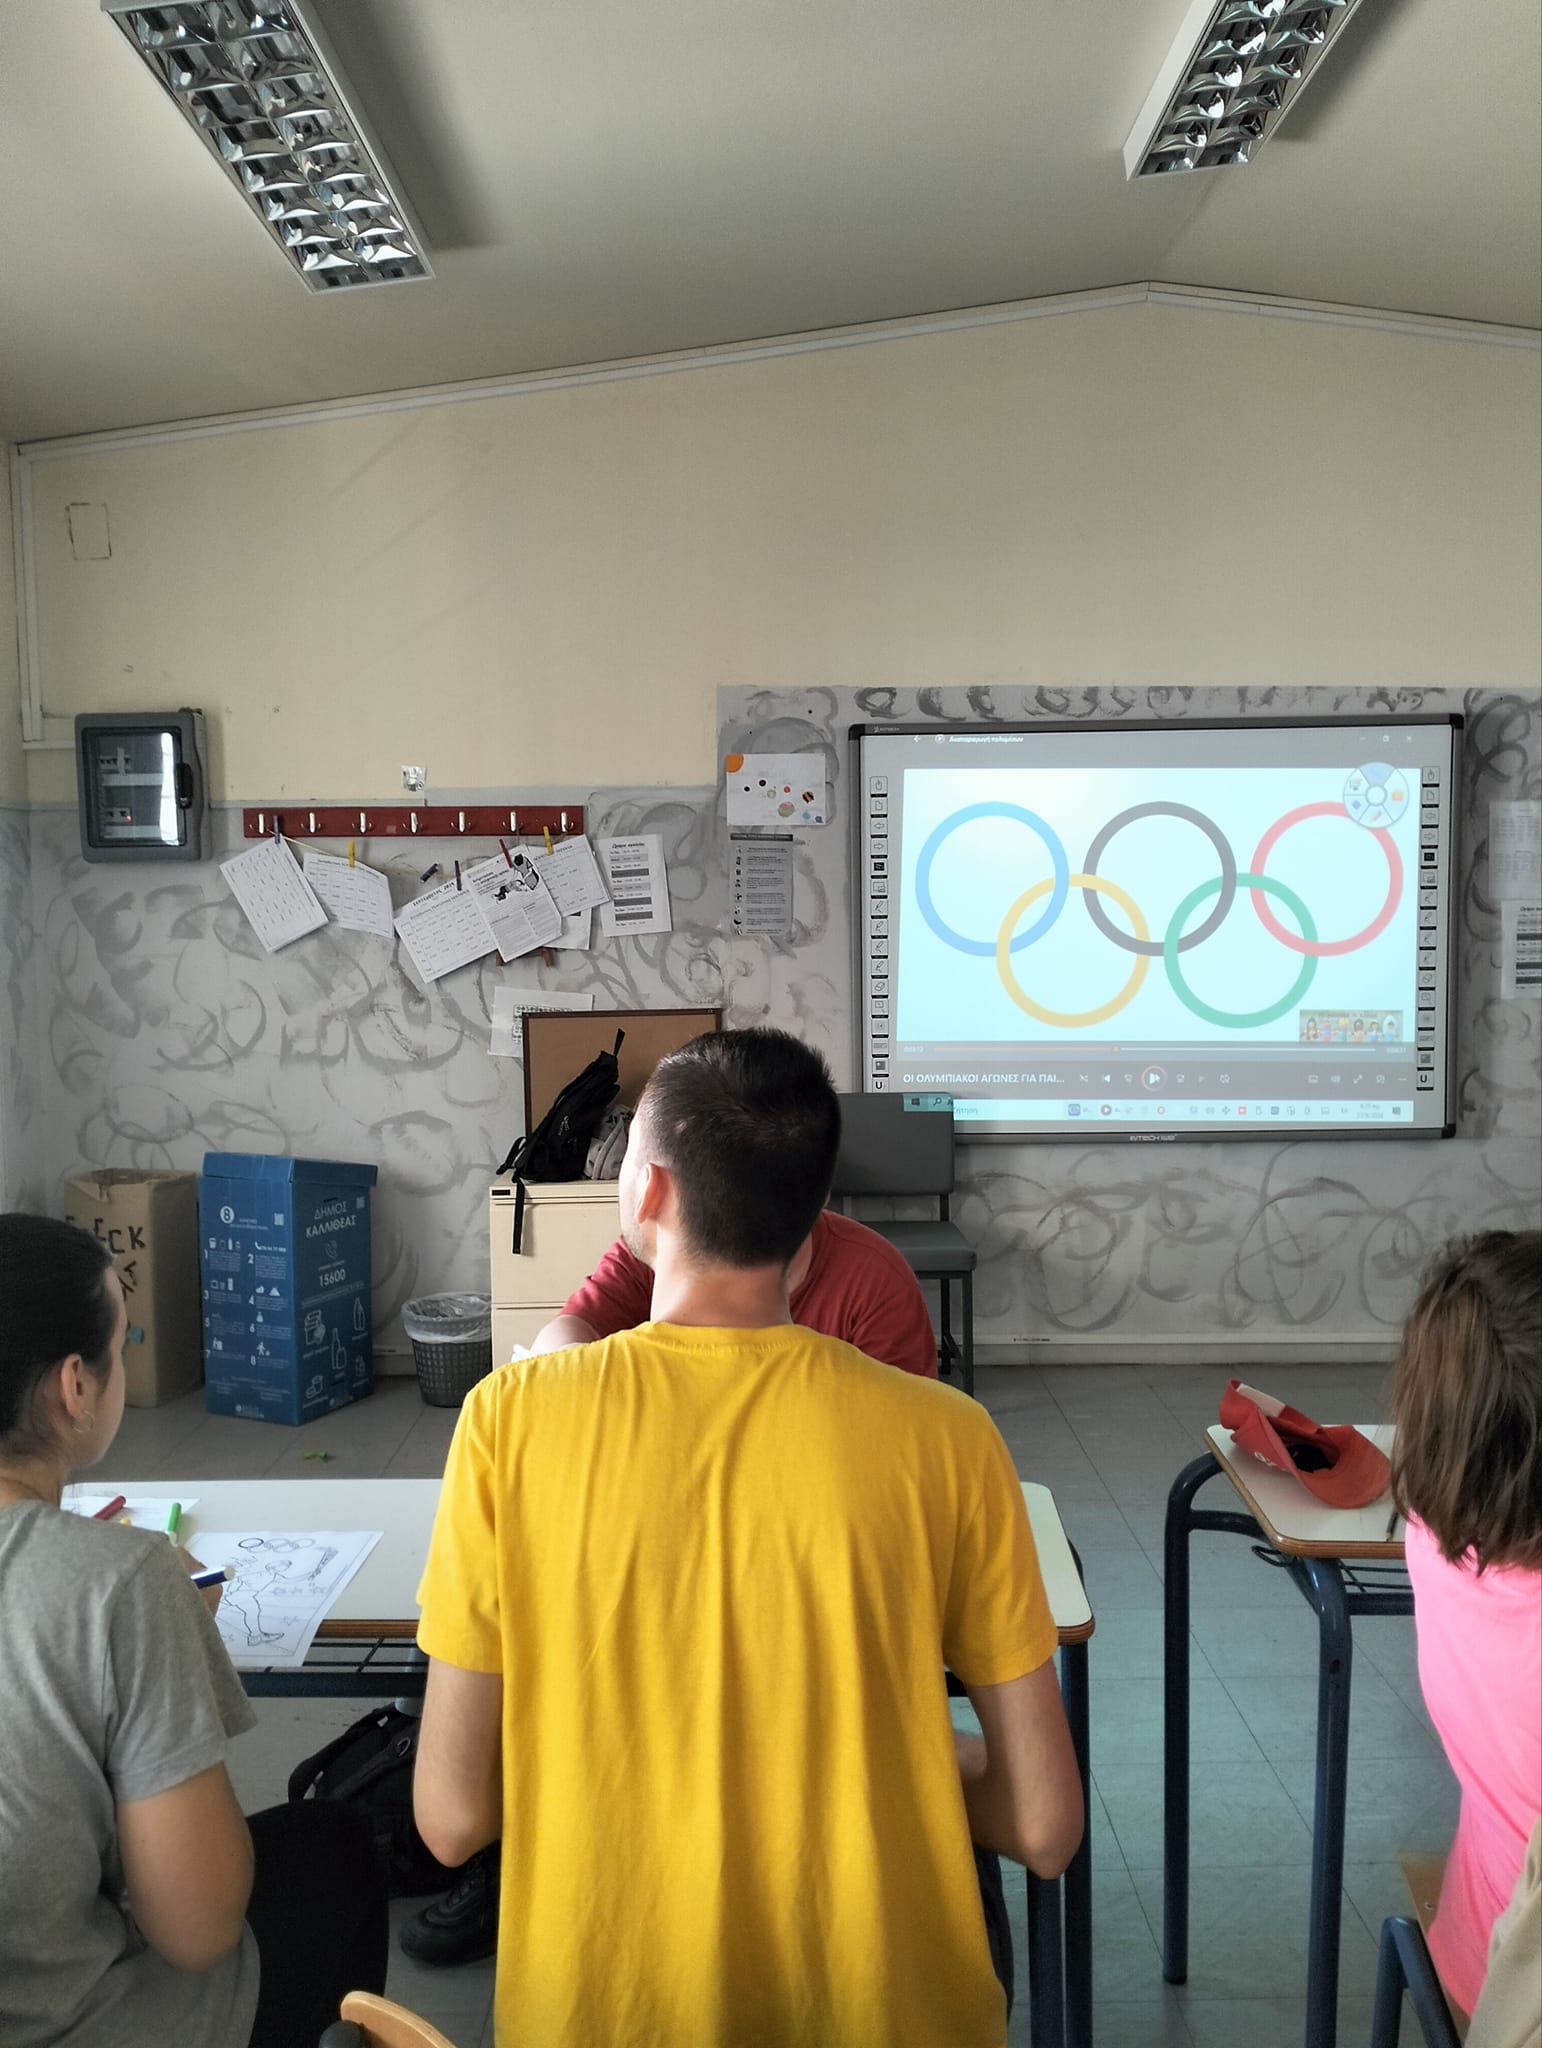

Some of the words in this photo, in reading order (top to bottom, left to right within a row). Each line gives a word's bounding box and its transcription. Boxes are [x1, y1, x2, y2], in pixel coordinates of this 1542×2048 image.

[903, 1074, 914, 1083] ΟΙ
[916, 1074, 979, 1083] ΟΛΥΜΠΙΑΚΟΙ
[980, 1074, 1019, 1083] ΑΓΩΝΕΣ
[1021, 1074, 1037, 1083] ΓΙΑ
[314, 1201, 347, 1220] ΔΗΜΟΣ
[305, 1214, 357, 1238] ΚΑΛΛΙΘΕΑΣ
[319, 1268, 347, 1287] 15600
